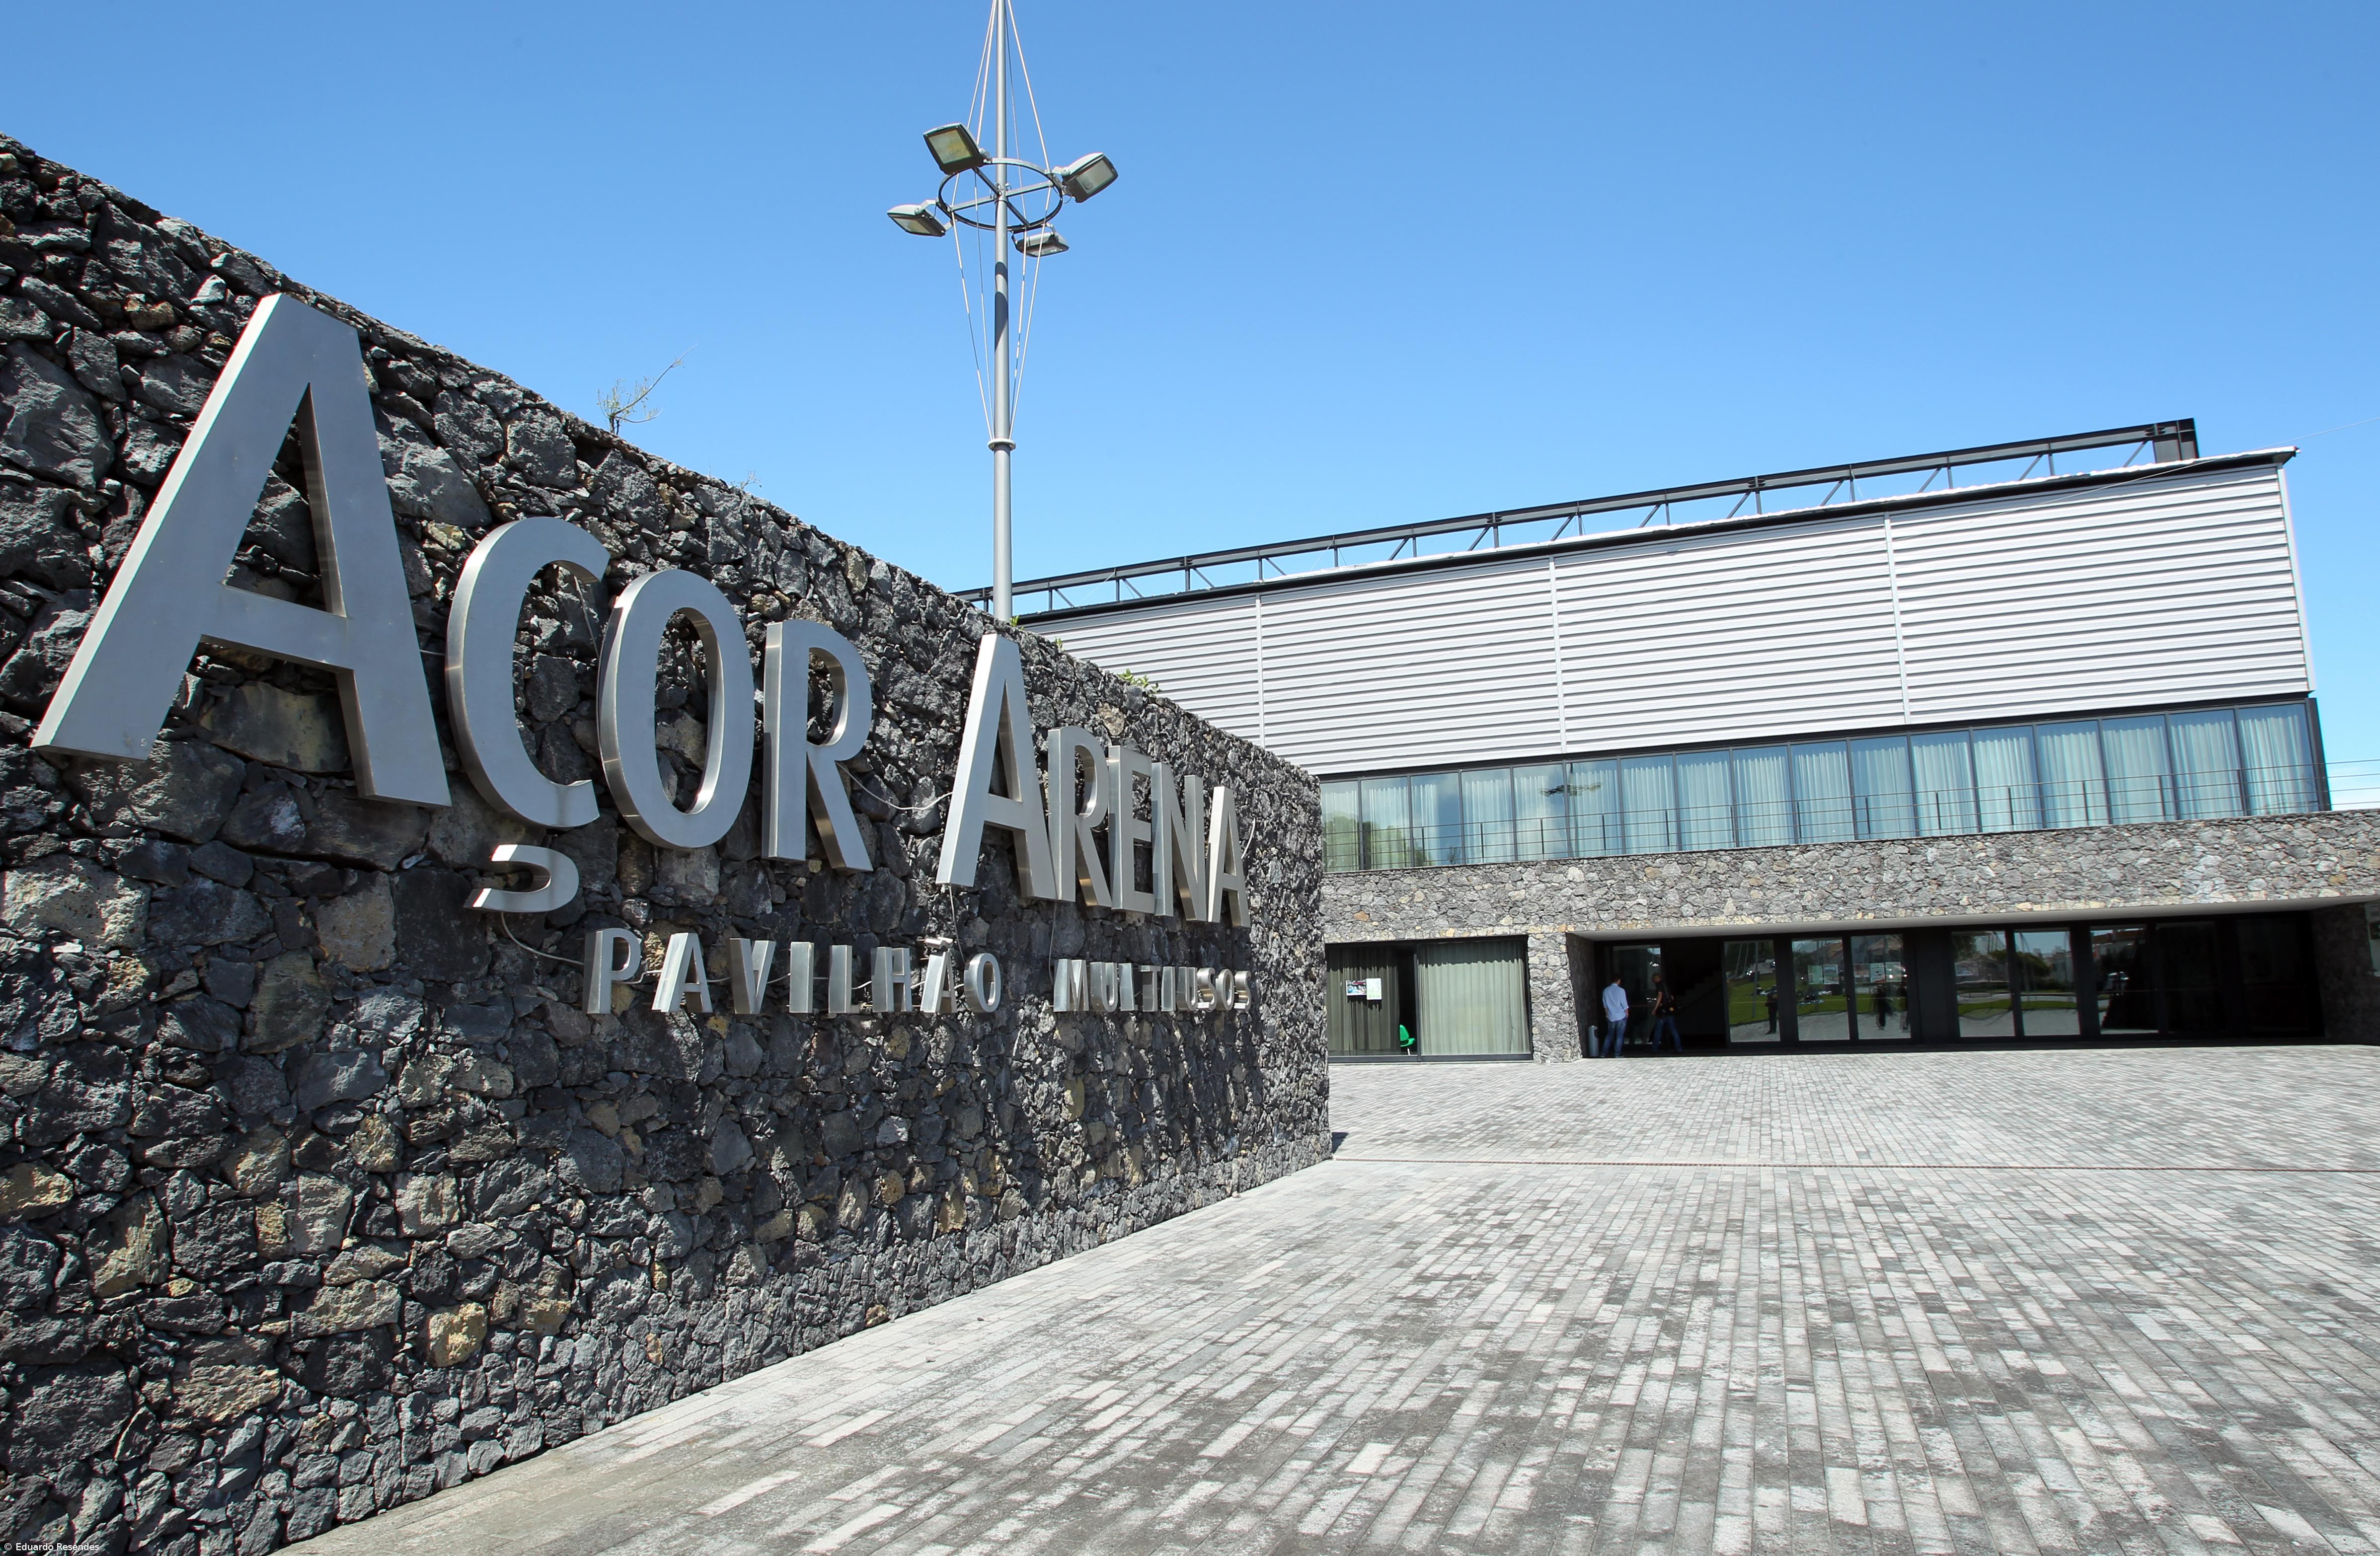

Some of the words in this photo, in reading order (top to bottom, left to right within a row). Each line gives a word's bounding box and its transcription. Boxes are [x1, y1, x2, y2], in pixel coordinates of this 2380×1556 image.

[31, 293, 873, 913] AÇOR
[936, 634, 1250, 928] ARENA
[586, 928, 1000, 1014] PAVILHÃO
[1053, 959, 1251, 1013] MULTIUSOS
